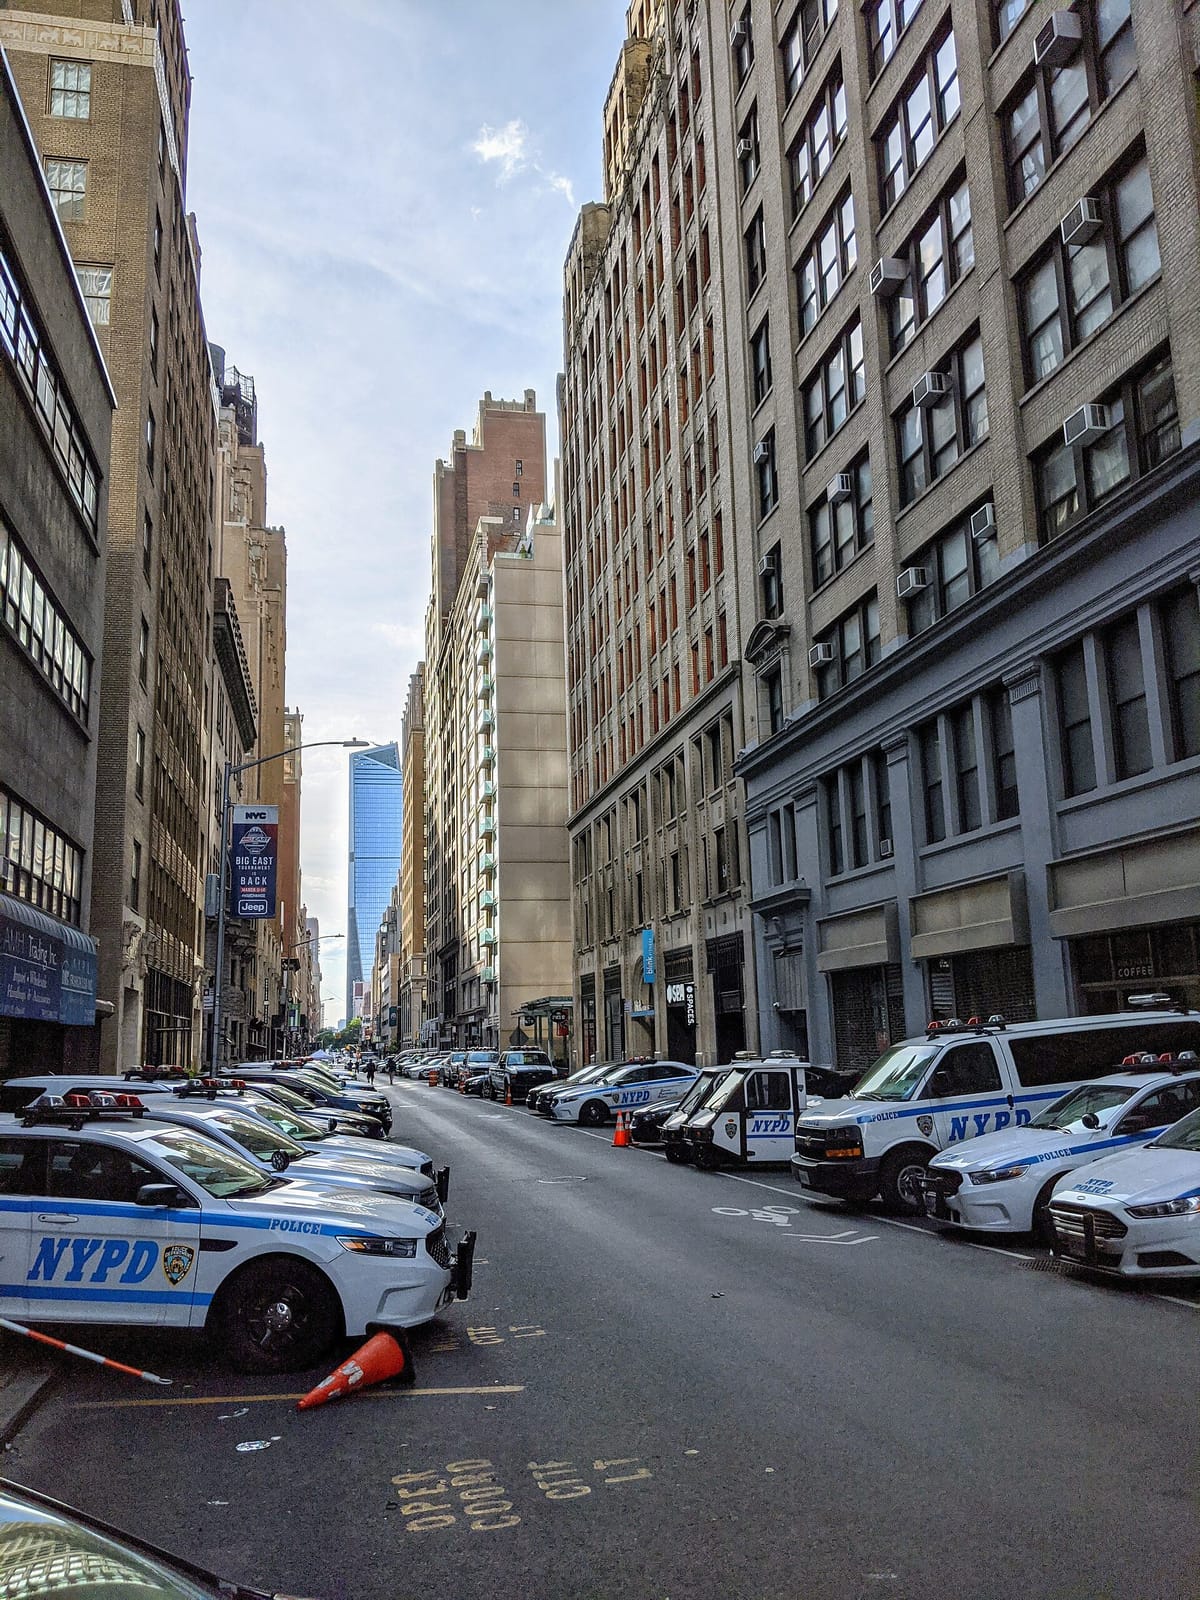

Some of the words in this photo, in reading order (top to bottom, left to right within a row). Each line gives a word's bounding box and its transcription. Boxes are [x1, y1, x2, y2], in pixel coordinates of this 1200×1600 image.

[245, 812, 267, 820] NYC
[235, 857, 250, 865] BIG
[252, 857, 274, 865] EAST
[240, 877, 268, 886] BACK
[241, 902, 265, 912] Jeep
[28, 934, 48, 970] Trading
[646, 956, 654, 975] blink
[1118, 965, 1153, 978] COFFEE
[621, 1090, 650, 1103] NYPD
[871, 1111, 898, 1122] POLICE
[751, 1119, 790, 1133] NYPD
[948, 1108, 1032, 1142] NYPD
[1038, 1148, 1071, 1162] POLICE
[1072, 1184, 1112, 1194] POLICE
[1086, 1178, 1114, 1187] NYPD
[269, 1218, 322, 1236] POLICE
[27, 1236, 159, 1284] NYPD
[391, 1469, 457, 1532] OPER
[445, 1458, 522, 1531] COORD
